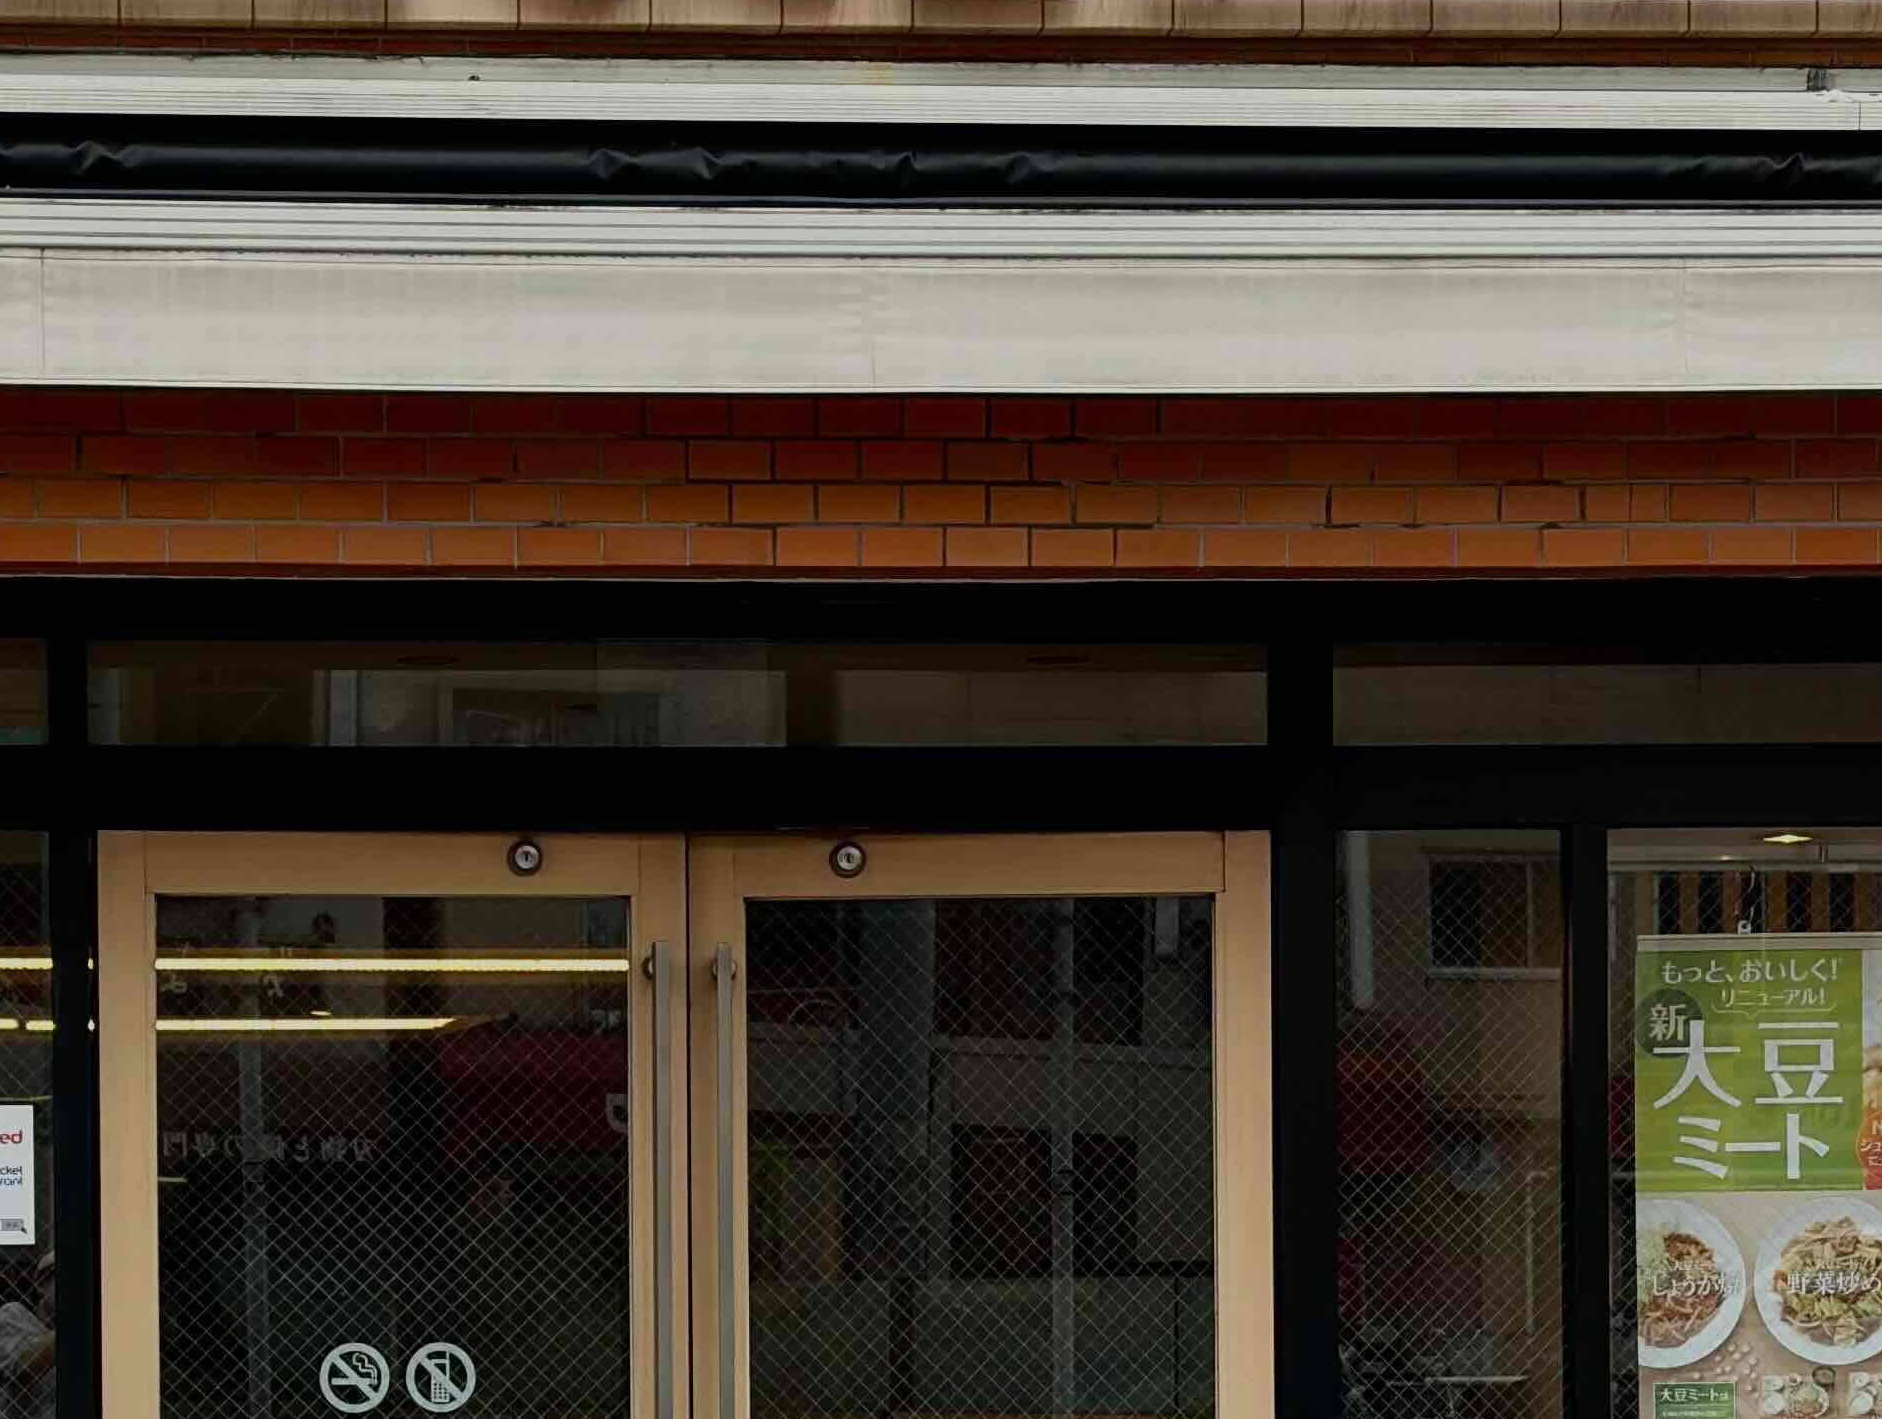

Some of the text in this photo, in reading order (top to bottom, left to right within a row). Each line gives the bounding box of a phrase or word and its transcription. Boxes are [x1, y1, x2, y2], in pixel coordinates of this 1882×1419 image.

[1650, 1004, 1687, 1041] 新
[1652, 1019, 1844, 1108] 大豆
[1672, 1113, 1831, 1181] ミート
[1787, 1270, 1882, 1295] 野菜炒め
